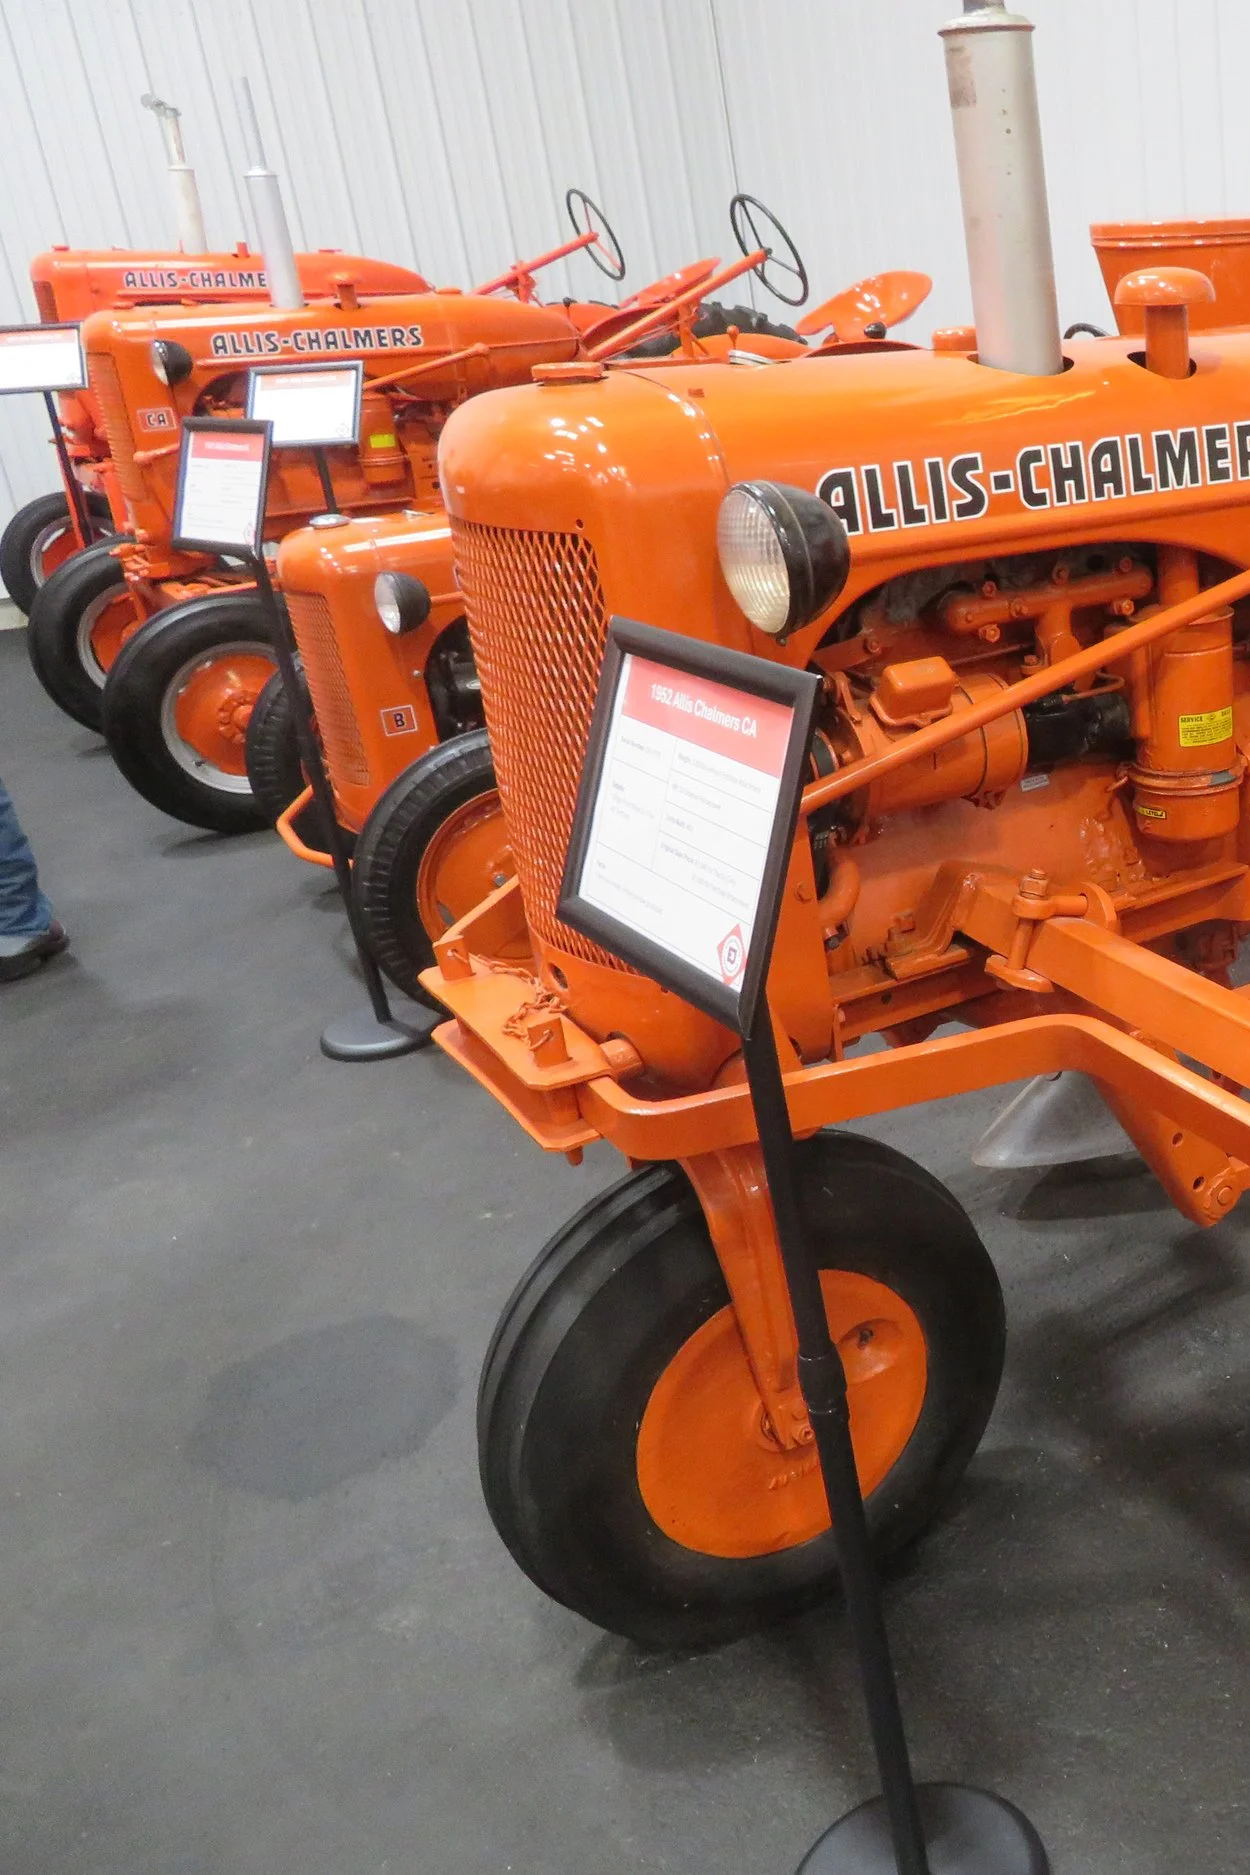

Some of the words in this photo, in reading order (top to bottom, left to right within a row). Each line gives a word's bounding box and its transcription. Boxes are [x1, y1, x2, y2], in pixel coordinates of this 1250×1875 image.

[123, 271, 267, 289] ALLIS-CHALME
[210, 325, 424, 356] ALLIS-CHALMERS
[146, 413, 168, 427] CA
[393, 712, 405, 728] B
[650, 684, 673, 705] 1952
[673, 692, 694, 714] Allis
[693, 699, 740, 731] Chalmers
[741, 717, 757, 738] CA
